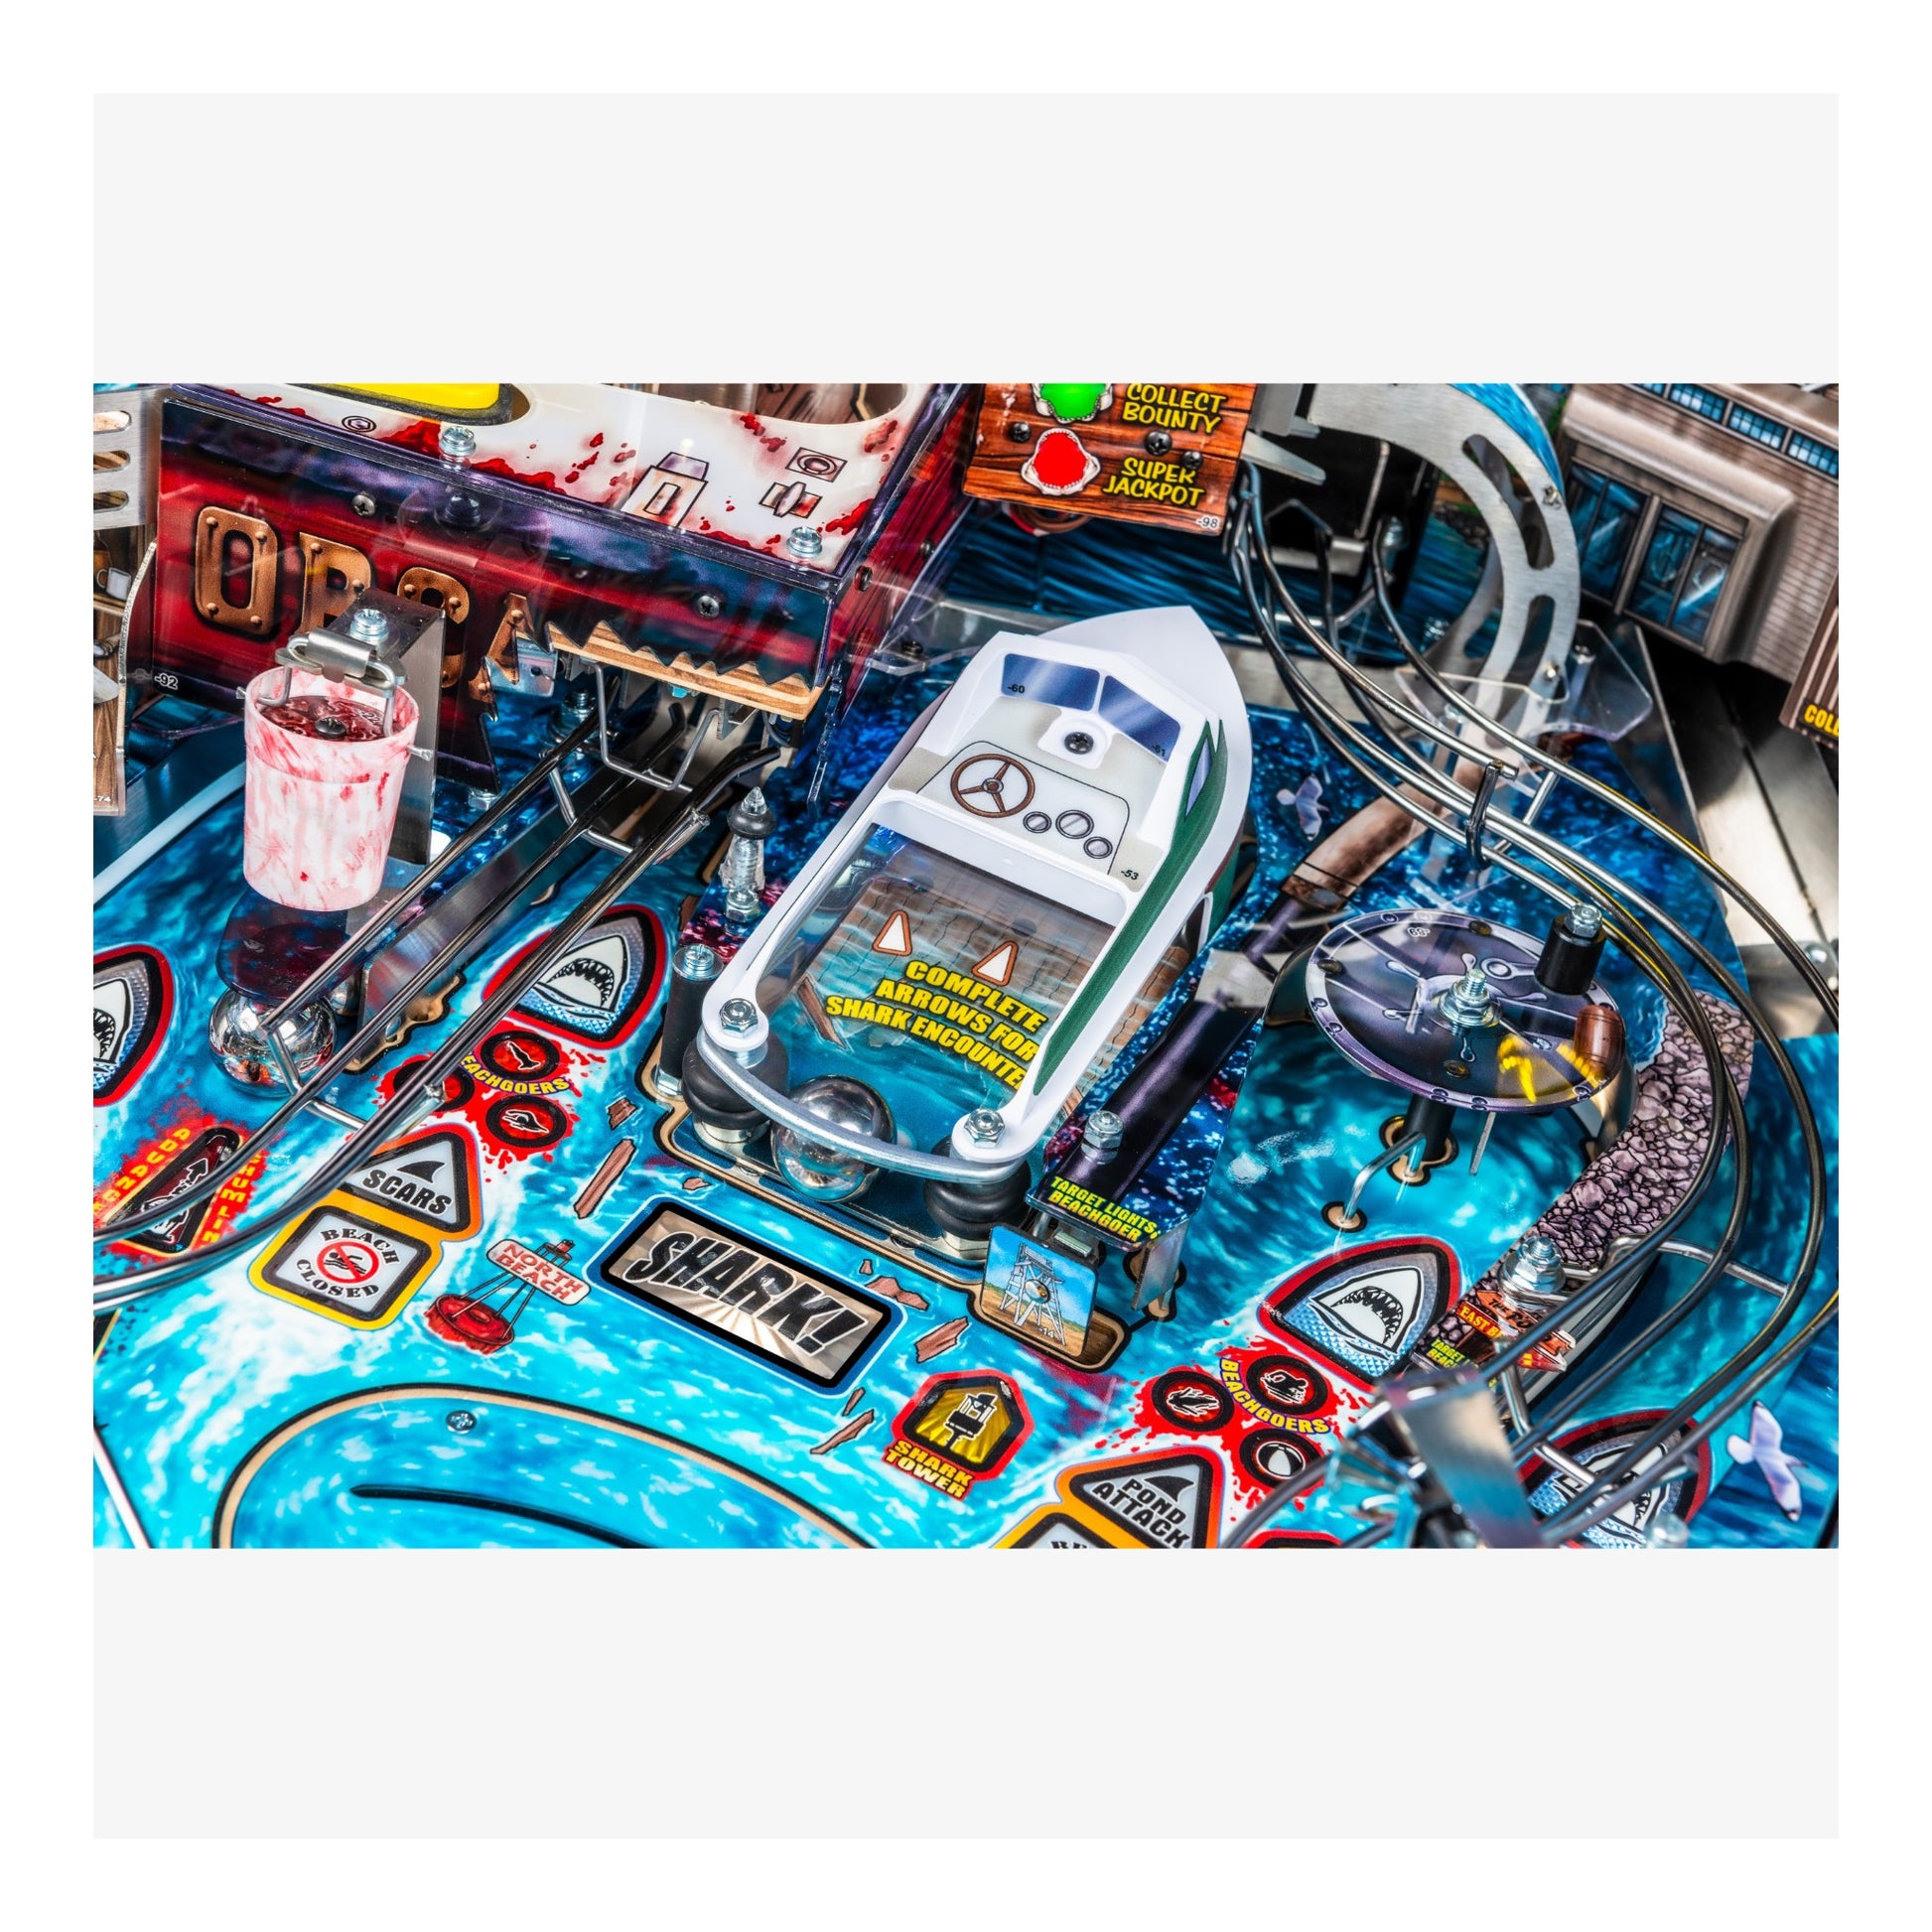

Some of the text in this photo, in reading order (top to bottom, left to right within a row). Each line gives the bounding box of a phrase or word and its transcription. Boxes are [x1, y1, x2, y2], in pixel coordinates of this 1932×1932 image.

[1122, 401, 1222, 434] BOUNTY
[1126, 383, 1227, 413] COLLECT
[1102, 475, 1206, 507] JACKPOT
[1120, 457, 1196, 484] SUPER
[1197, 516, 1219, 529] -98
[155, 673, 179, 691] -92
[1007, 684, 1026, 694] -60
[1120, 869, 1140, 882] -53
[904, 959, 1048, 1034] COMPLETE
[874, 978, 1040, 1062] ARROWS FOR
[825, 994, 1028, 1091] SHARK ENCOUNTE
[460, 1052, 571, 1095] EACHGOERS
[362, 1169, 453, 1215] SCARS
[1051, 1175, 1107, 1209] TARGET
[1048, 1190, 1142, 1242] BEACHGOER
[320, 1227, 401, 1265] BEACH
[296, 1259, 379, 1299] CLOSED
[495, 1254, 571, 1300] BEACH
[503, 1243, 584, 1293] NORTH
[622, 1231, 869, 1356] SHARK!
[1038, 1326, 1055, 1338] -14
[1459, 1306, 1488, 1332] EAST
[1431, 1338, 1465, 1363] TARGET
[1220, 1358, 1330, 1434] BEACHGOERS
[886, 1449, 966, 1498] TOWER
[894, 1440, 974, 1486] SHARK
[1091, 1481, 1190, 1549] ATTACK
[1122, 1477, 1187, 1525] POND
